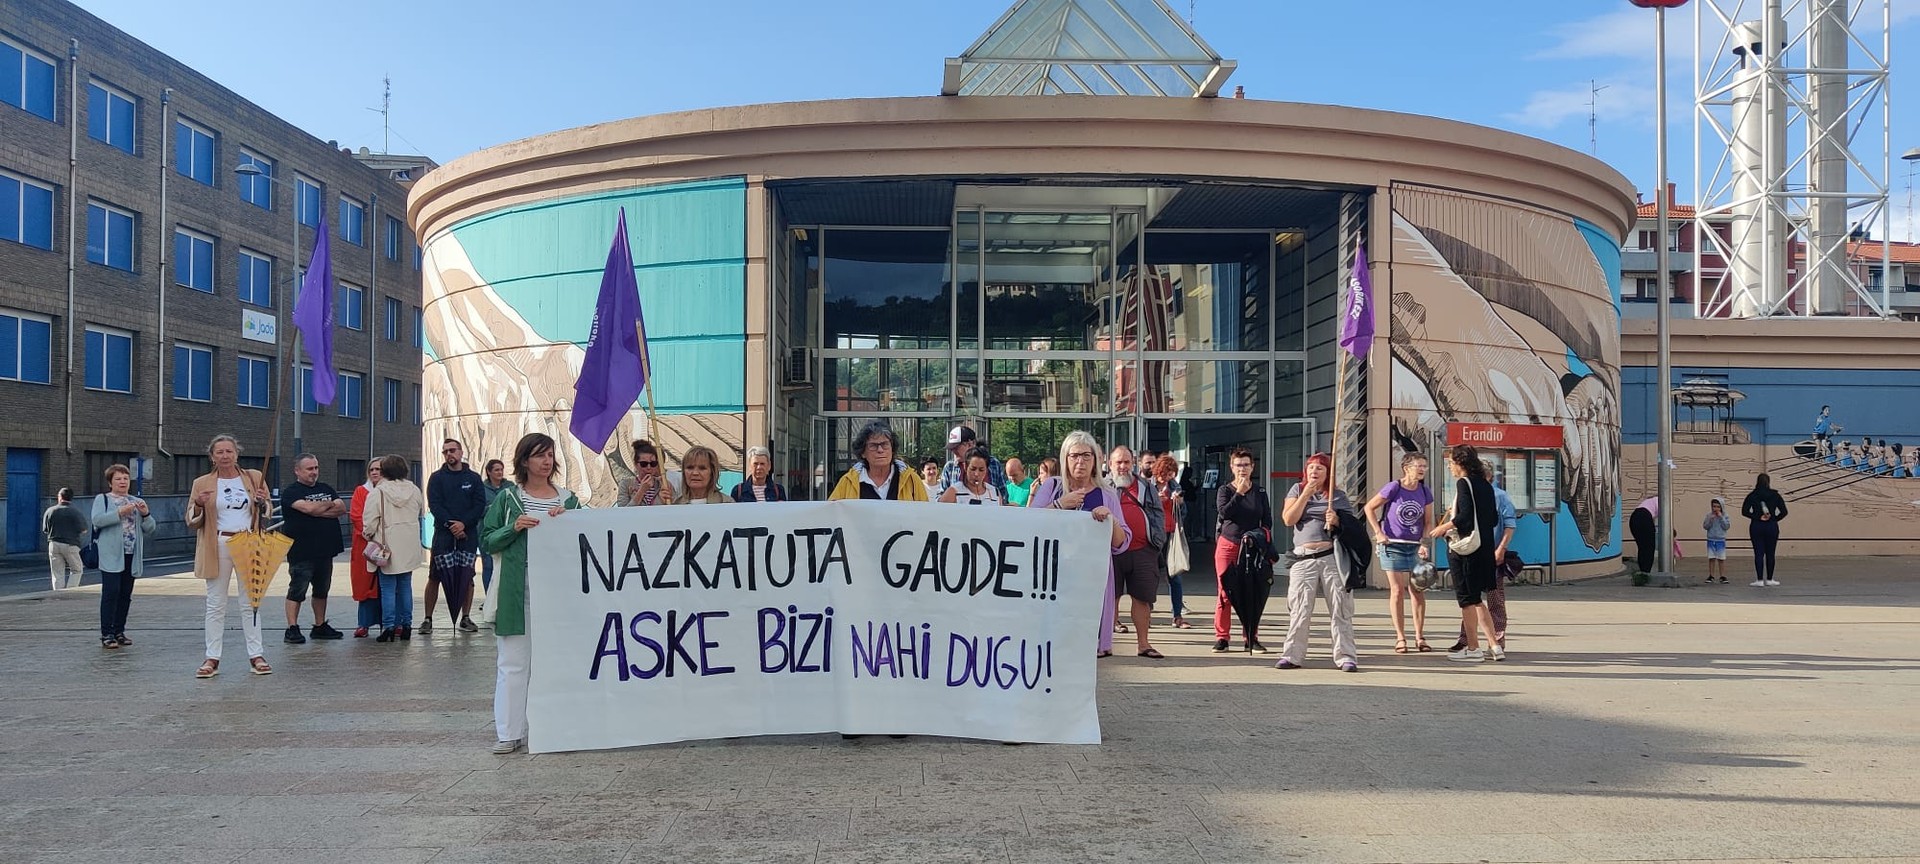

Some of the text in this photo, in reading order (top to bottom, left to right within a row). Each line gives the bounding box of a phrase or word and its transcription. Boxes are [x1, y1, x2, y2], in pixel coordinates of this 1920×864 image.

[1462, 426, 1503, 442] Erandio
[578, 527, 1059, 600] NAZKATUTA GAUDE!!!
[589, 609, 735, 681] ASKE
[947, 632, 1052, 693] DUGU!
